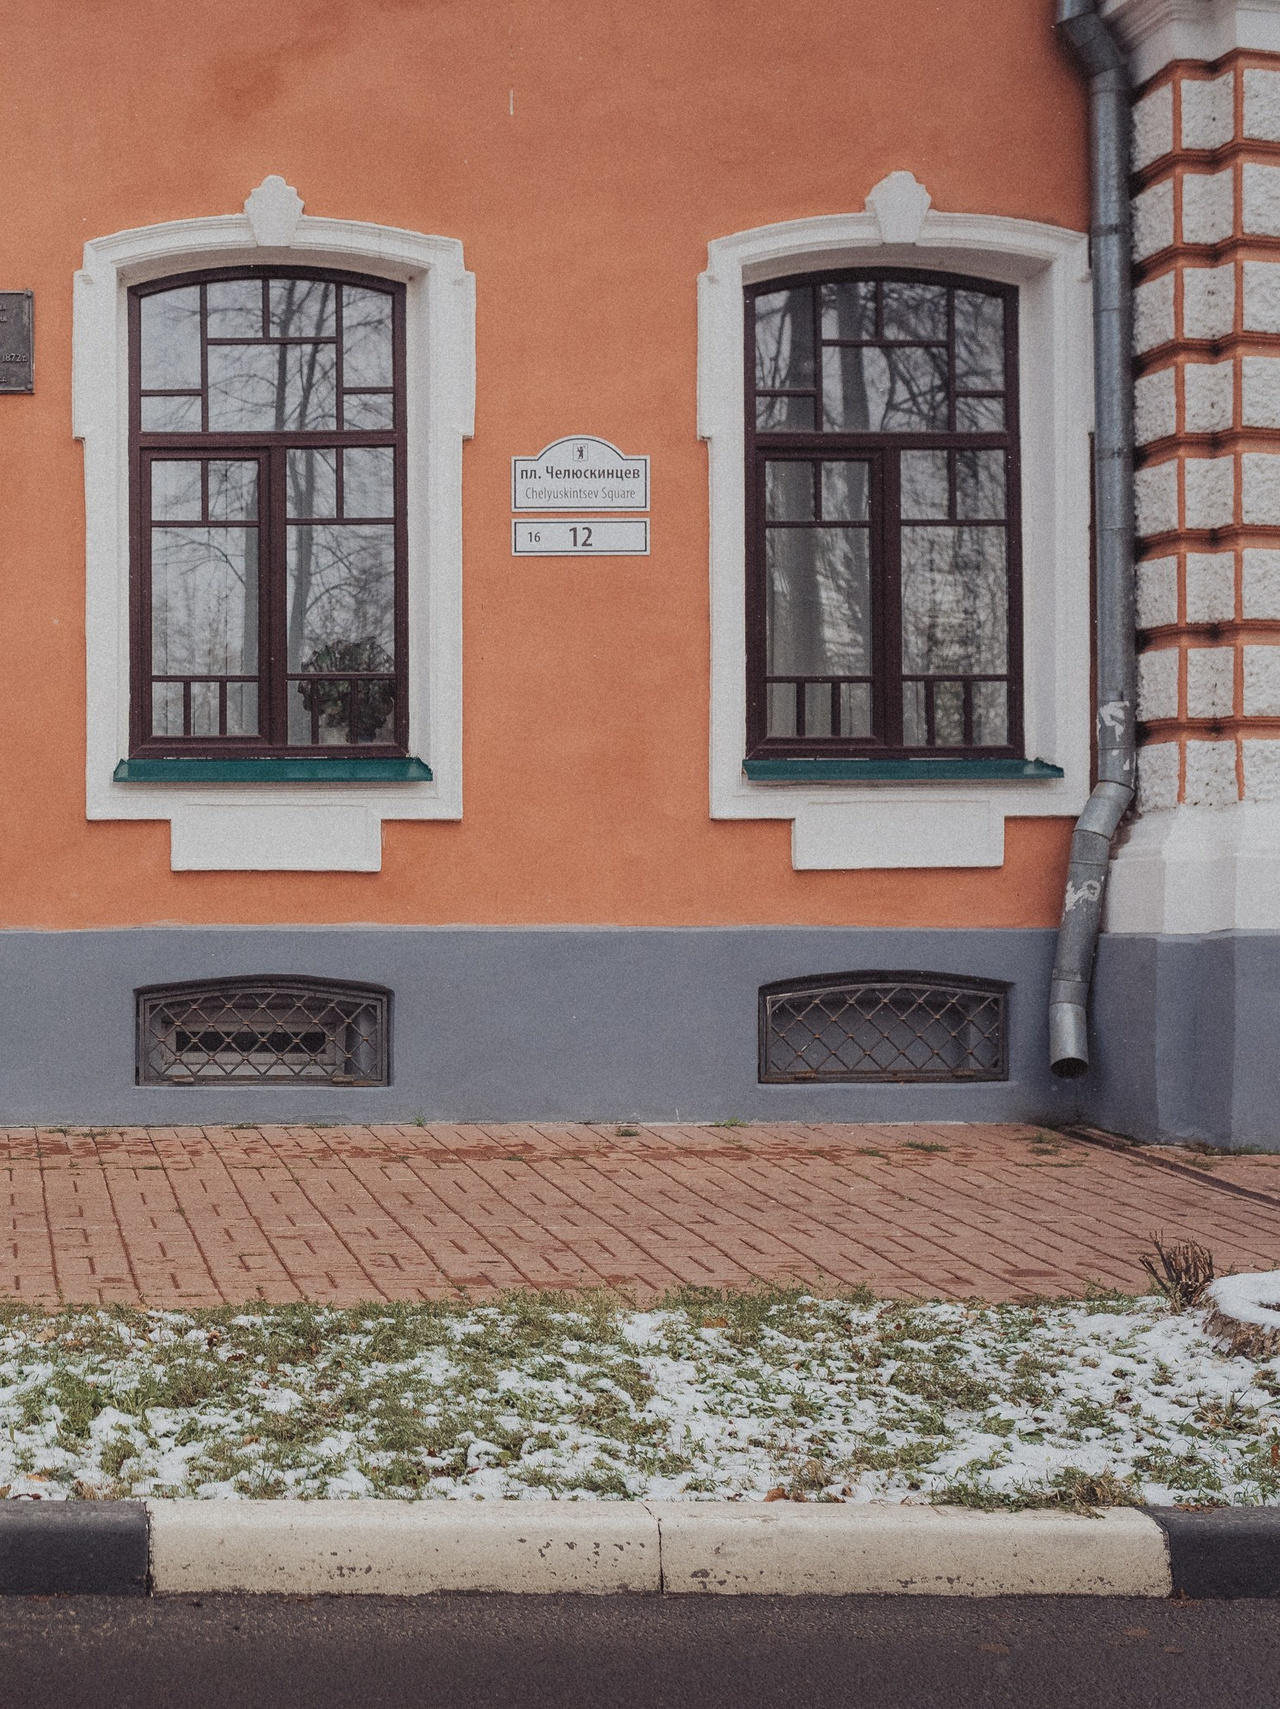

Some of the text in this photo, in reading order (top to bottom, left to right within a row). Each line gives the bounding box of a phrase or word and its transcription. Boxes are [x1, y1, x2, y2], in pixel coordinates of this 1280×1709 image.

[520, 466, 640, 481] пл. Челюскинцев
[525, 487, 636, 502] Chelyuskintsev Square
[528, 532, 541, 543] 16
[569, 527, 593, 547] 12
